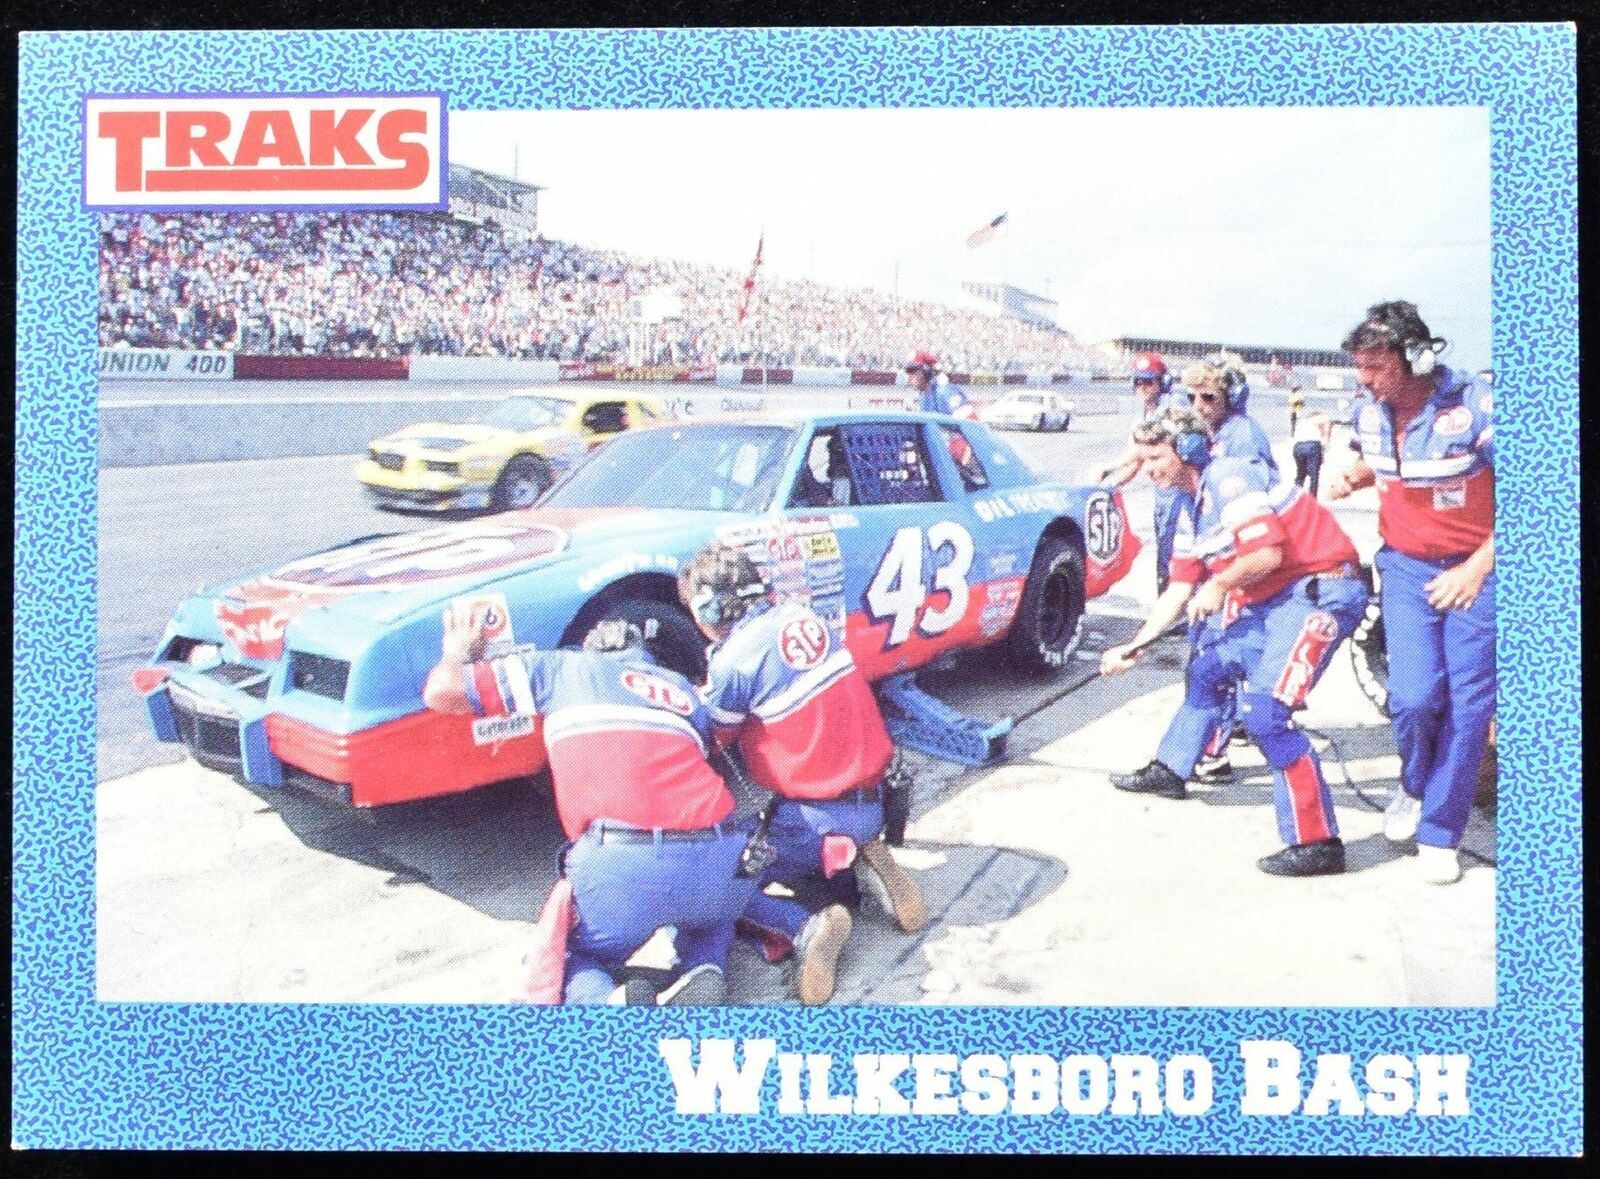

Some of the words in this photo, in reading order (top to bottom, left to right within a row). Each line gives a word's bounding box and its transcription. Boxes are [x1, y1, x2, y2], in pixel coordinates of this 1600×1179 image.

[97, 108, 430, 193] TRAKS
[183, 353, 227, 373] 400
[1089, 499, 1121, 553] STP
[865, 519, 976, 649] 43
[782, 618, 826, 665] STP
[659, 1037, 1213, 1116] WILKESBORO
[1240, 1039, 1470, 1117] BASH
